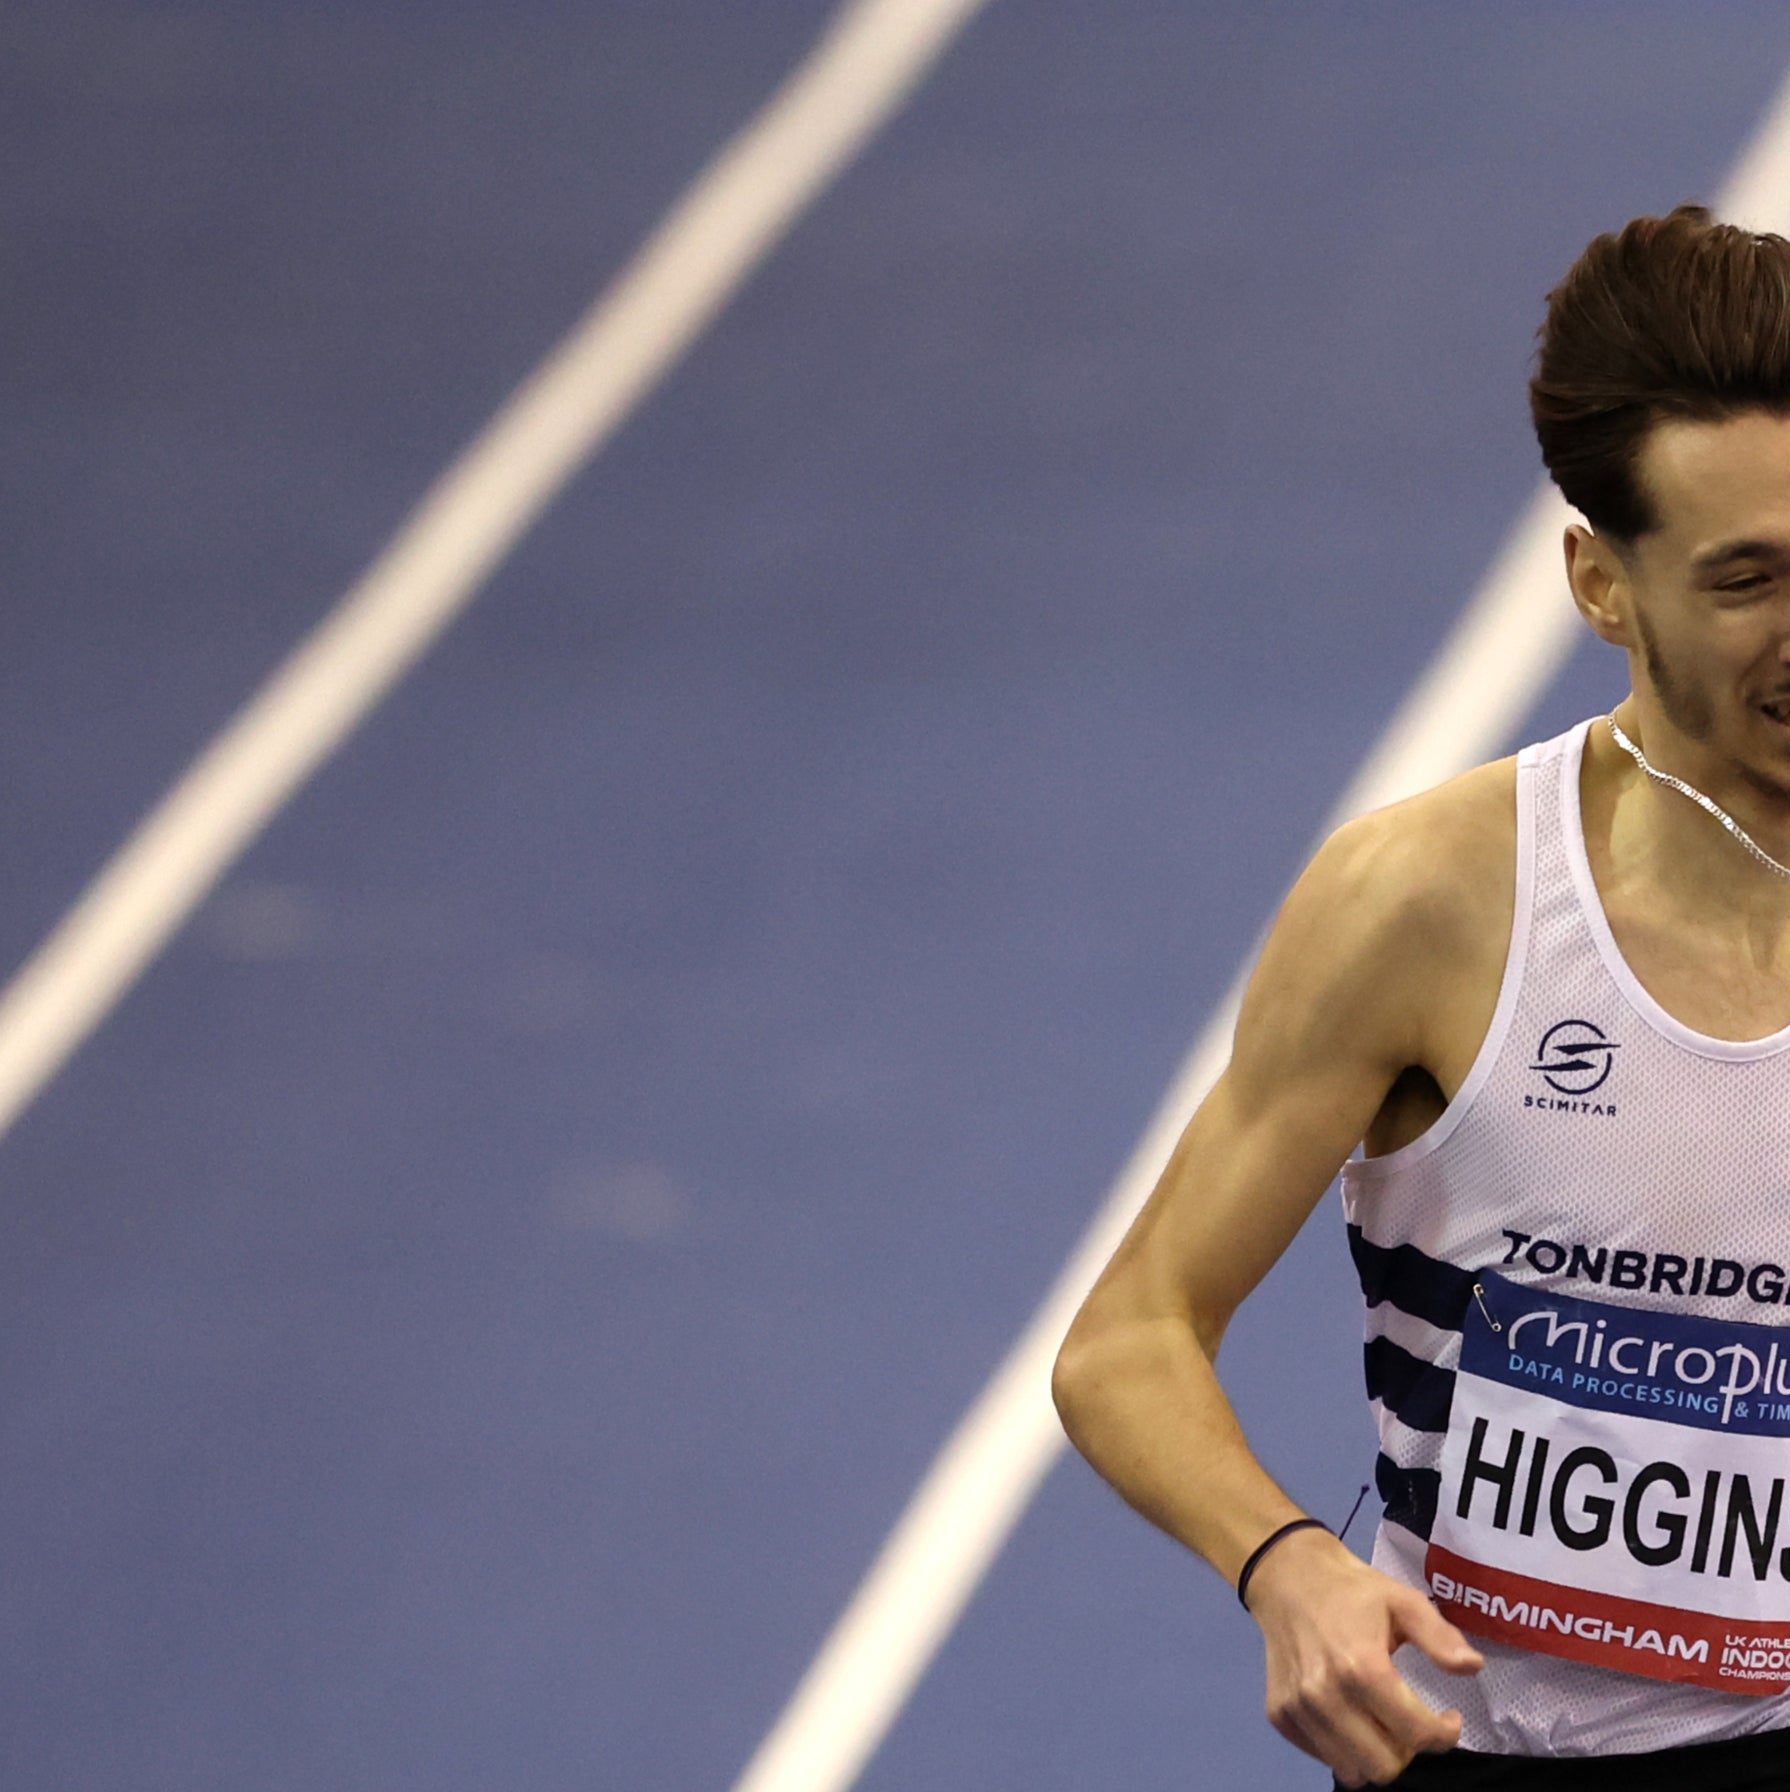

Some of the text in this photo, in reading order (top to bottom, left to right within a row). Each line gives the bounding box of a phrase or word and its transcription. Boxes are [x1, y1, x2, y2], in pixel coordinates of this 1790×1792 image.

[1523, 1094, 1618, 1118] SCIMITAR
[1508, 1353, 1566, 1389] DATA
[1573, 1371, 1720, 1416] PROCESSING
[1734, 1402, 1751, 1420] &
[1431, 1572, 1710, 1664] BIRMINGHAM
[1725, 1634, 1747, 1647] UK
